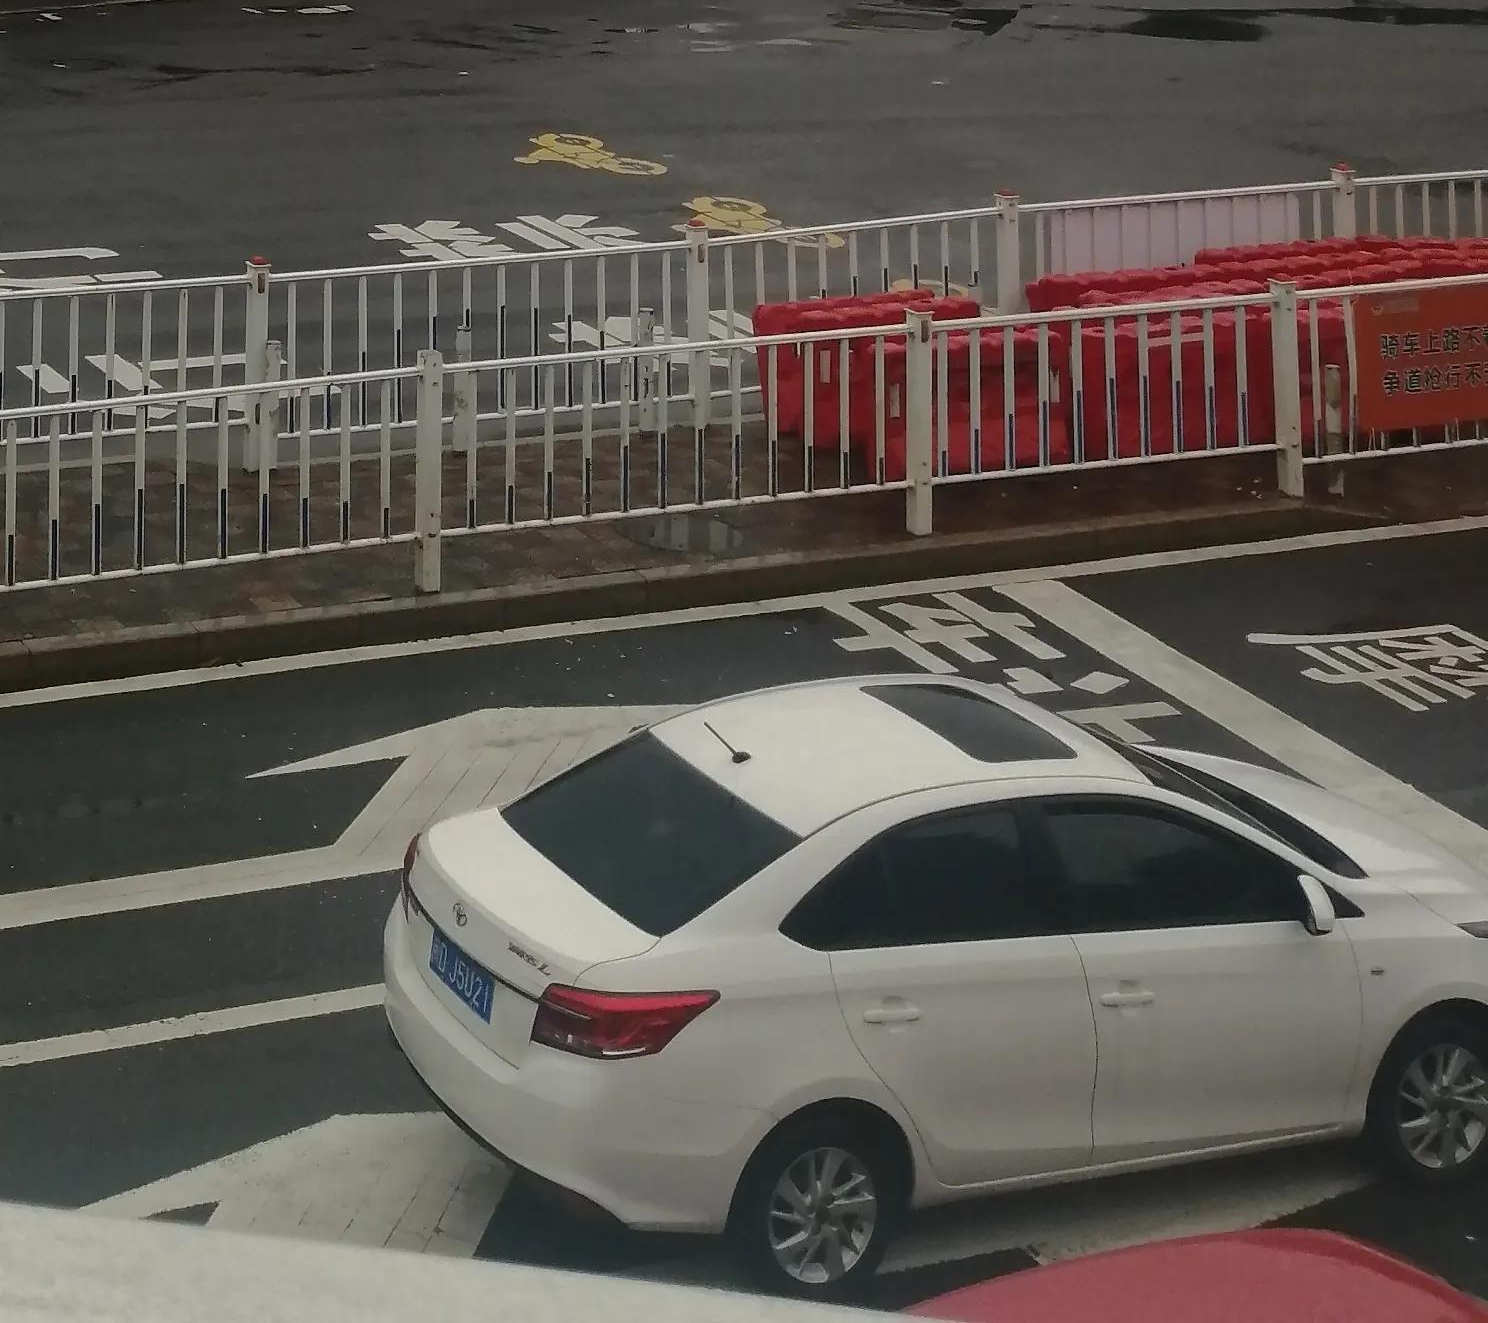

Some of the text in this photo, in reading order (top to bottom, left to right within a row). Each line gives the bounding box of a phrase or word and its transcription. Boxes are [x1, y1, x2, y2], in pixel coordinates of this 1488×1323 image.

[1383, 362, 1488, 395] 争道抢行不
